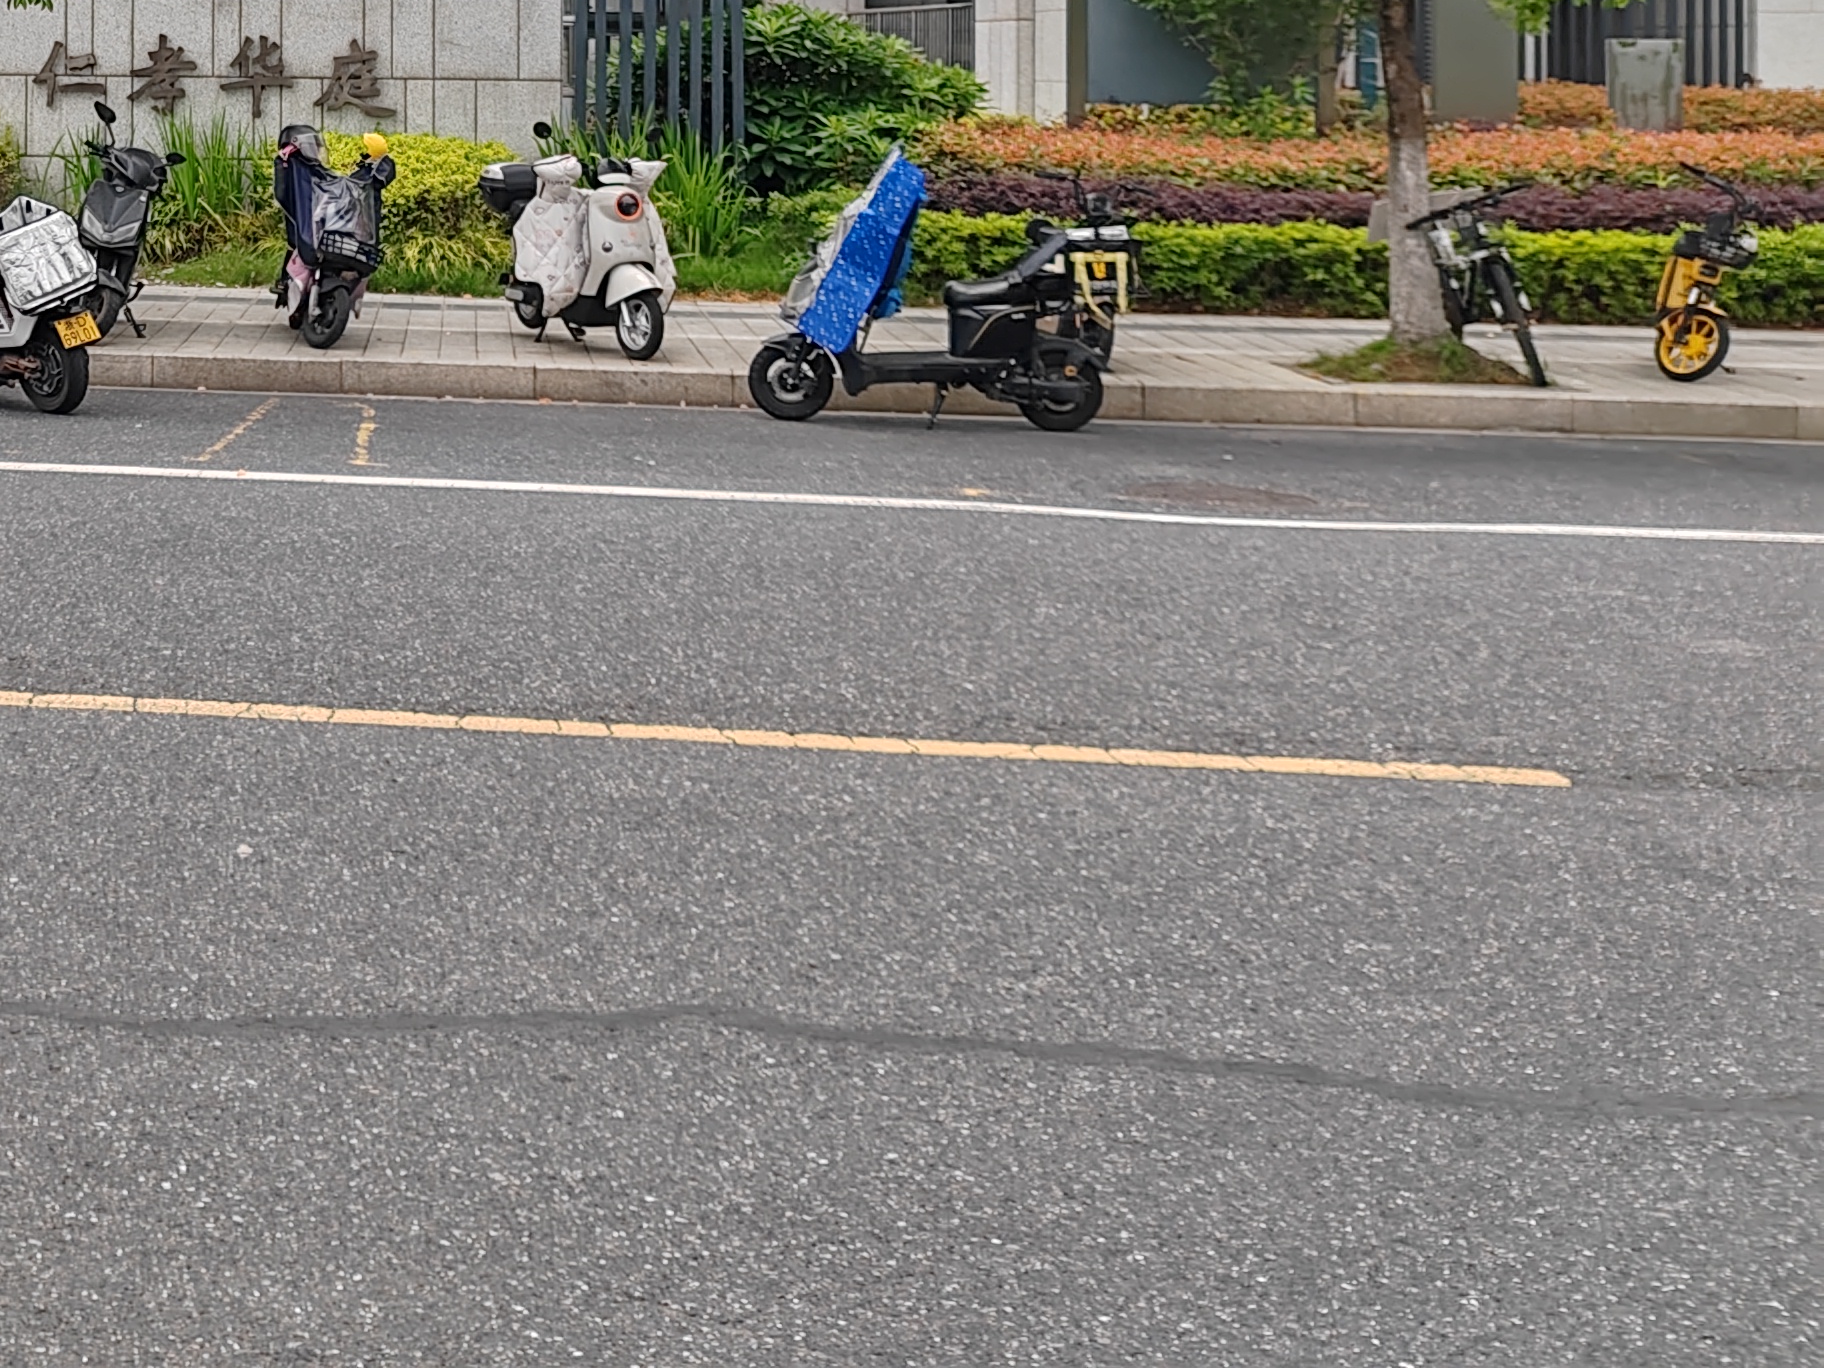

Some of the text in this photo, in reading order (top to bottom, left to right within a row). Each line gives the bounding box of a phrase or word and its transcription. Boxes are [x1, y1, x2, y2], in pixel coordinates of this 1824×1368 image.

[33, 34, 397, 119] 仁孝华庭
[63, 326, 97, 346] 69L01
